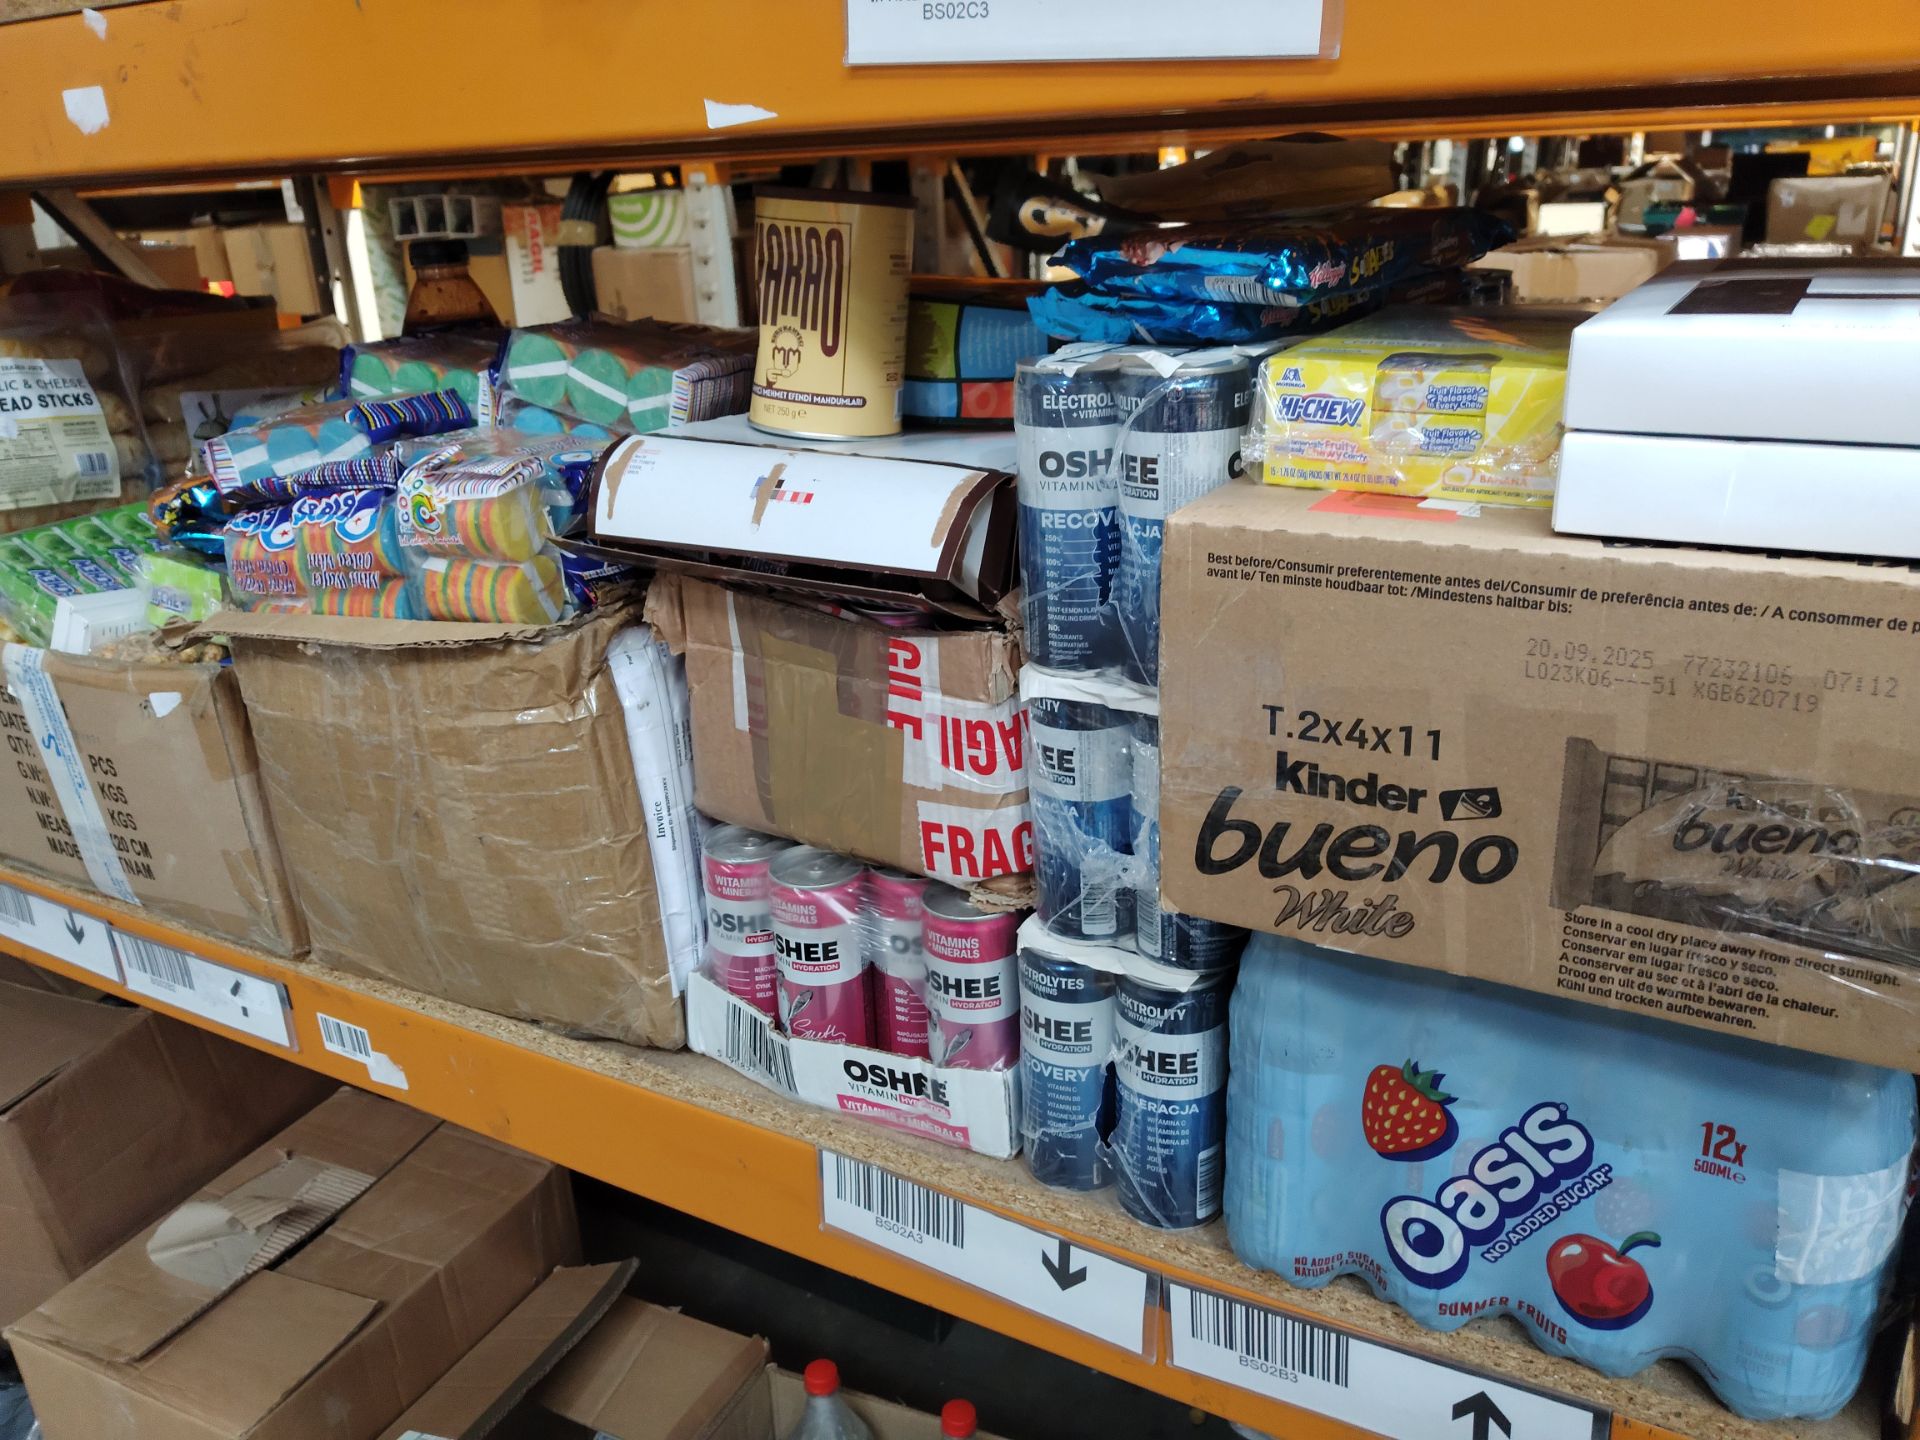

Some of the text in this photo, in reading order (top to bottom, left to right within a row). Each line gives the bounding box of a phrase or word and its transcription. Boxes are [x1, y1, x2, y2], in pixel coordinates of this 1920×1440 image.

[922, 1, 990, 20] BS02C3
[23, 378, 87, 390] & CHEESE
[1428, 385, 1475, 396] Fruit Flavor
[37, 392, 94, 409] STICKS
[762, 388, 787, 400] MEHMET
[788, 391, 812, 403] EFENDİ
[813, 395, 863, 406] MAHDUMLARI
[1436, 401, 1483, 411] Every Chew
[1437, 393, 1478, 403] Released
[763, 403, 790, 417] NET 250
[1277, 395, 1366, 427] HI-CHEW
[1421, 427, 1468, 438] Fruit Flavor
[1325, 440, 1357, 453] Fruity
[1206, 566, 1573, 614] avant le/ Ten minste houdbaar tot: /Mindestens haltbar bis:
[1207, 552, 1908, 632] Best before/Consumir preferentemente antes del/Consumir de preferência antes de: A consommer de
[1048, 640, 1089, 649] PRESERVATIVES
[1525, 637, 1655, 670] 20.09.2025
[1823, 669, 1900, 699] 07:12
[1692, 679, 1819, 714] XGB620719
[1261, 703, 1442, 761] T.2x4x11
[7, 735, 36, 758] QTY:
[88, 754, 118, 777] PCS
[97, 781, 128, 805] KGS
[1275, 750, 1428, 814] Kinder
[107, 807, 138, 832] KGS
[654, 800, 666, 839] Invoice
[1672, 806, 1862, 855] bueno
[1194, 785, 1519, 885] bueno
[130, 838, 153, 860] CM
[1272, 884, 1416, 939] White
[927, 929, 980, 949] VITAMINS
[1562, 924, 1777, 977] Conservar en lugar fresco y seco.
[1564, 911, 1902, 988] Store in a cool dry place away from direct sunlight.
[932, 945, 980, 959] MINERALS
[792, 962, 840, 973] HYDRATION
[1561, 938, 1779, 993] Conservar em lugar fresco e seco.
[1558, 952, 1839, 1019] A conserver au sec et à l'abri de la chaleur.
[1558, 964, 1770, 1019] Droog en uit de warmte bewaren.
[951, 999, 1001, 1011] HYDRATION
[1557, 977, 1757, 1031] Kühl und trocken aufbewahren.
[1040, 1038, 1092, 1053] HYDRATION
[842, 1058, 950, 1108] OSHEE
[1047, 1082, 1072, 1093] VITAMIN
[1142, 1073, 1198, 1087] HYDRATION
[847, 1081, 898, 1103] VITAMIN
[1047, 1092, 1072, 1102] VITAMIN
[1047, 1102, 1072, 1112] VITAMIN
[1047, 1110, 1085, 1121] MAGNESIUM
[1146, 1116, 1180, 1127] WITAMINA
[1146, 1126, 1180, 1136] WITAMINA
[1700, 1120, 1748, 1169] 12x
[1382, 1103, 1591, 1282] Oasis
[874, 1215, 925, 1245] BS02A3
[1484, 1203, 1560, 1264] NO ADDED
[1294, 1256, 1308, 1266] NO
[1310, 1252, 1343, 1267] ADDED
[1294, 1263, 1335, 1277] NATURAL
[1438, 1296, 1568, 1346] SUMMER FRUITS
[1238, 1354, 1299, 1385] BS02B3
